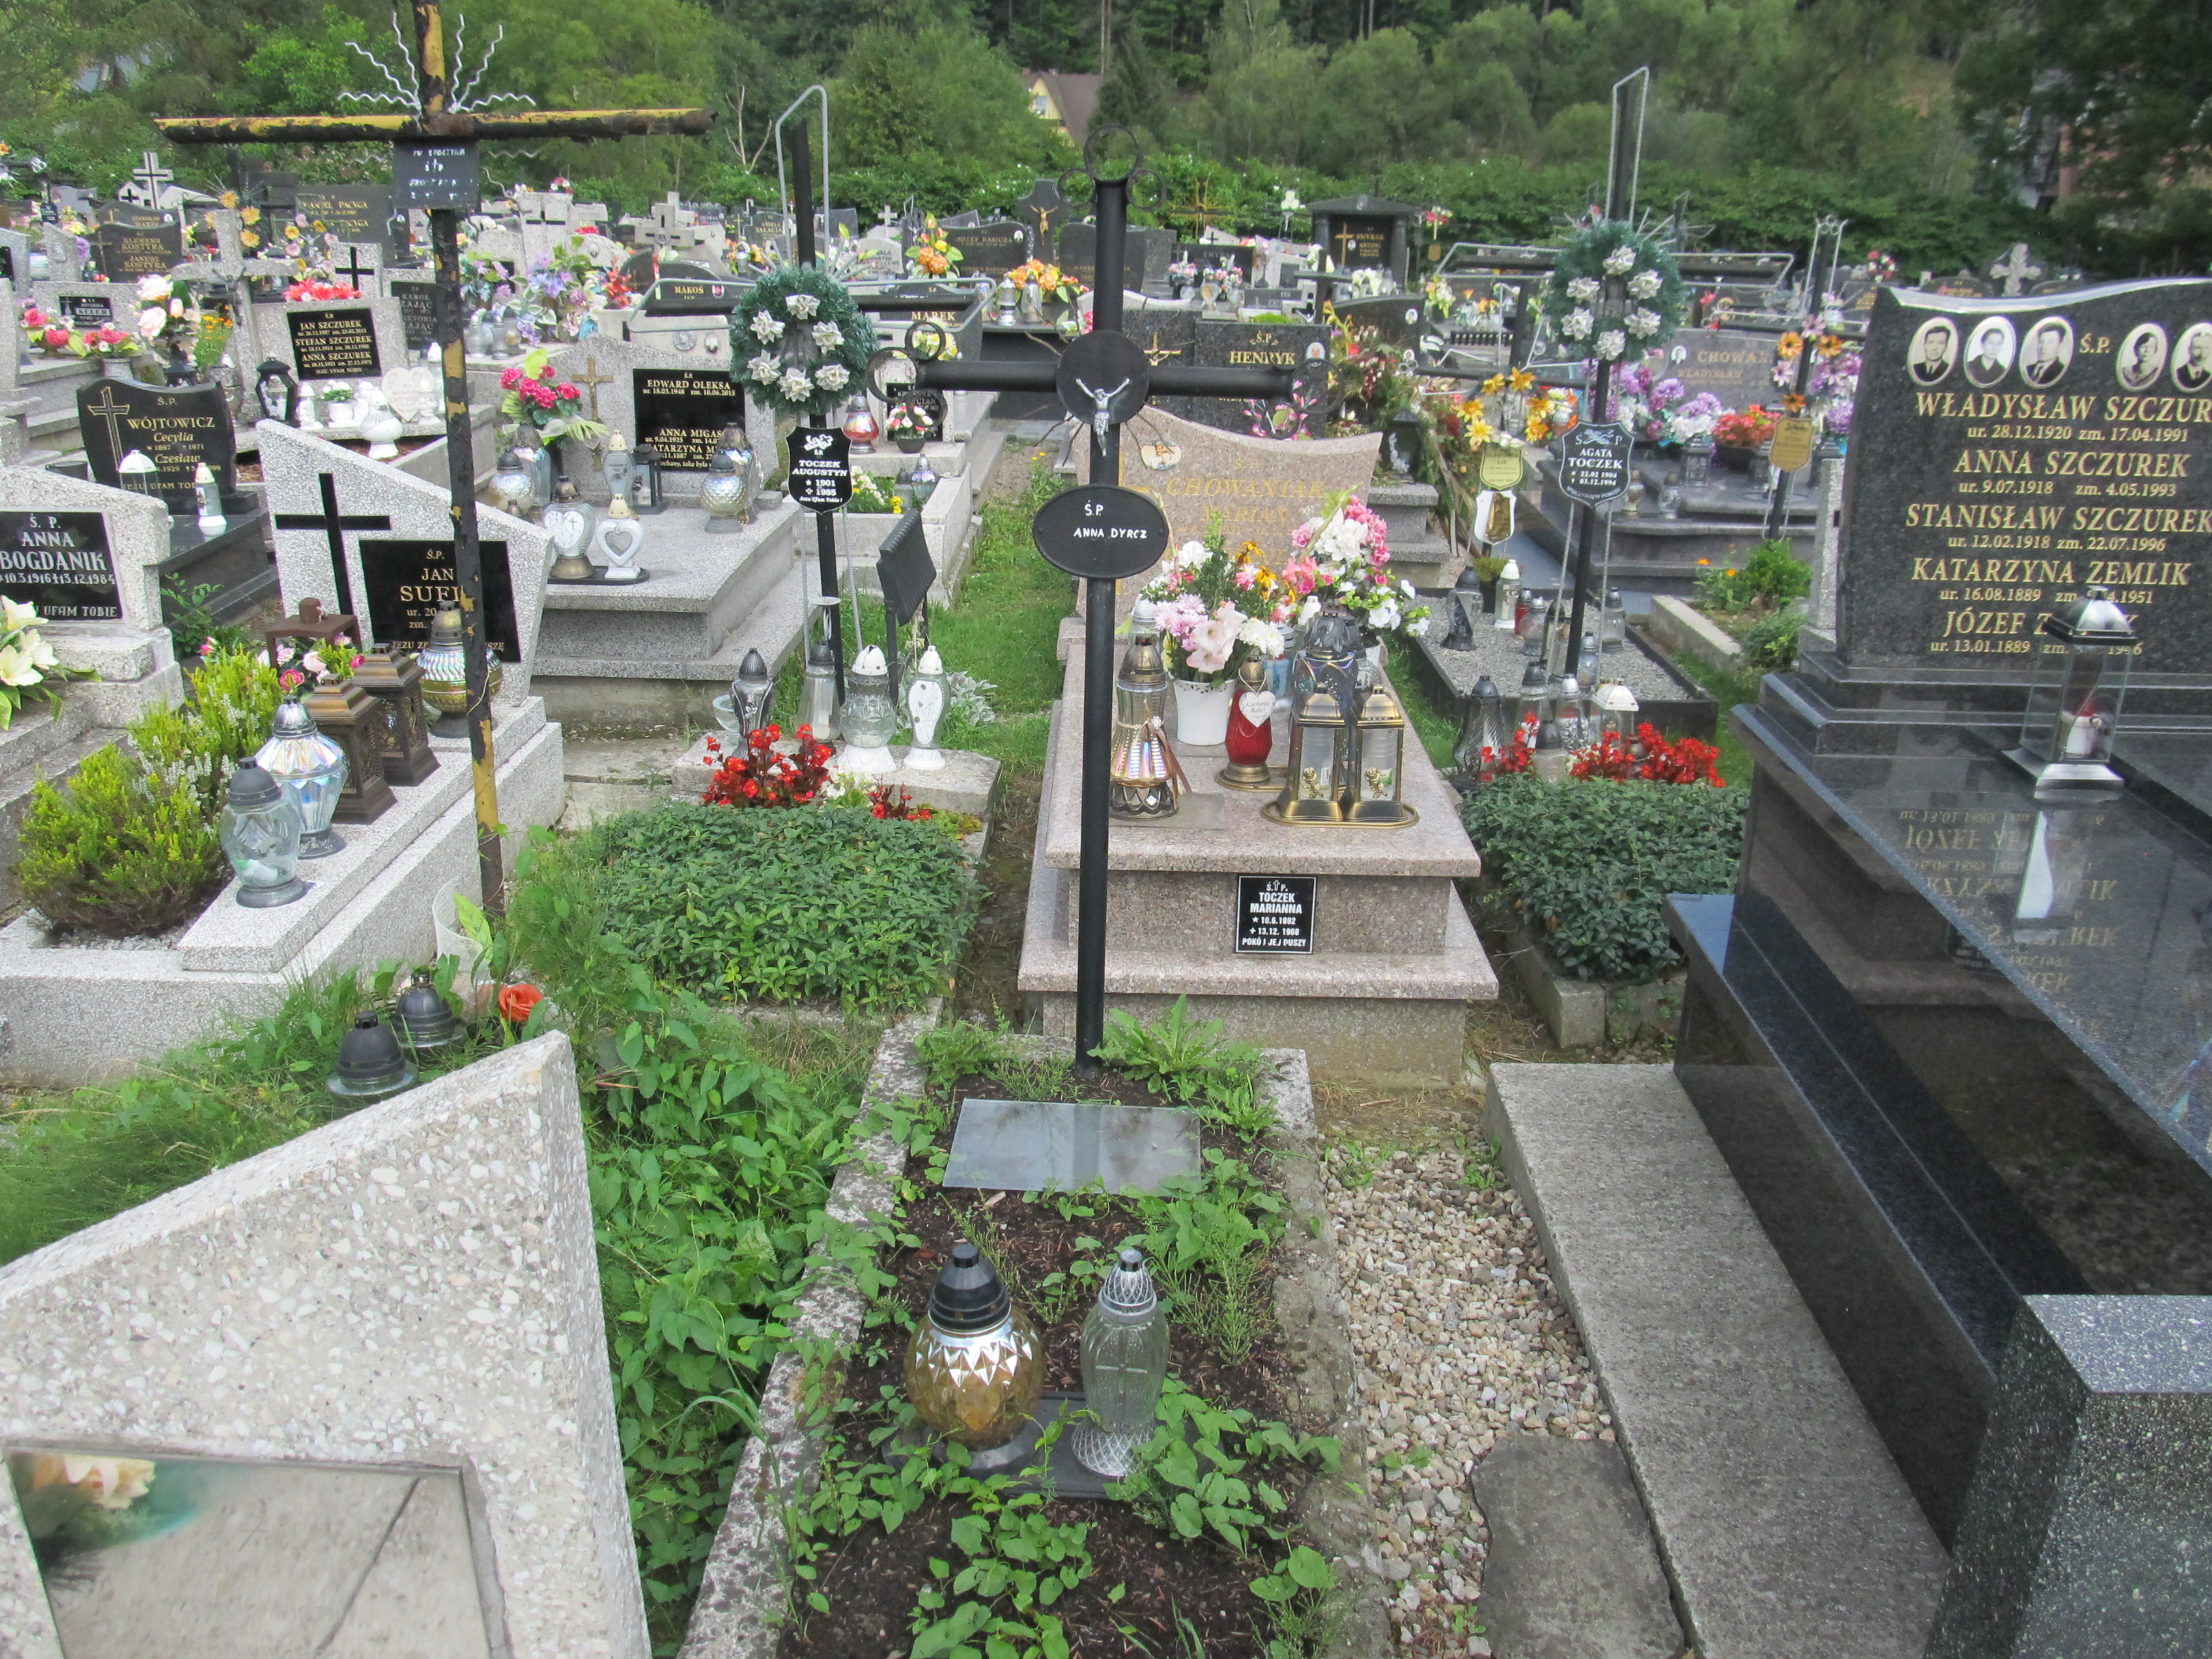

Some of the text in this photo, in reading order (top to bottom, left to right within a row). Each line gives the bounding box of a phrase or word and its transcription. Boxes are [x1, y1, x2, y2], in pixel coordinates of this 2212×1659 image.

[300, 320, 362, 331] JAN SZCZUREK
[329, 335, 372, 344] SZCZUREK
[302, 351, 372, 361] ANNA SZCZUREK
[1229, 350, 1296, 365] HENRYK
[647, 379, 731, 390] EDWARD OLEKSA
[1916, 392, 2097, 419] WŁADYSŁAW
[127, 416, 215, 430] WÓJTOWICZ
[154, 432, 193, 443] Cecylia
[1968, 425, 2189, 442] ur. 28.12.1920 zm. 17.04.1991
[645, 444, 702, 453] ATARZYNA
[1580, 448, 1613, 457] AGATA
[155, 454, 200, 463] Czesław
[799, 460, 841, 468] TOCZEK
[1568, 457, 1624, 469] TOCZEK
[1954, 449, 2192, 478] ANNA SZCZUREK
[1166, 478, 1326, 498] CHOWANIAK
[1958, 480, 2177, 496] ur. 9.07.1918 zm. 4.05.1993
[1906, 503, 2212, 533] STANISŁAW SZCZUREK
[22, 531, 75, 548] ANNA
[1073, 527, 1147, 539] ANNA DYRCZ
[1948, 535, 2166, 551] ur. 12.02.1918 zm. 22.07.1996
[0, 551, 108, 571] BOGDANIK
[422, 568, 455, 580] JAN
[1911, 558, 2192, 585] KATARZYNA ZEMLIK
[1940, 588, 2078, 602] ur. 16.08.1889 zm
[44, 606, 117, 617] UFAM TOBIE
[1943, 606, 2027, 637] JÓZEF
[1930, 639, 2069, 654] ur. 13.01.1889 zm.
[1259, 892, 1295, 903] TOCZEK
[1250, 903, 1302, 914] MARIANNA
